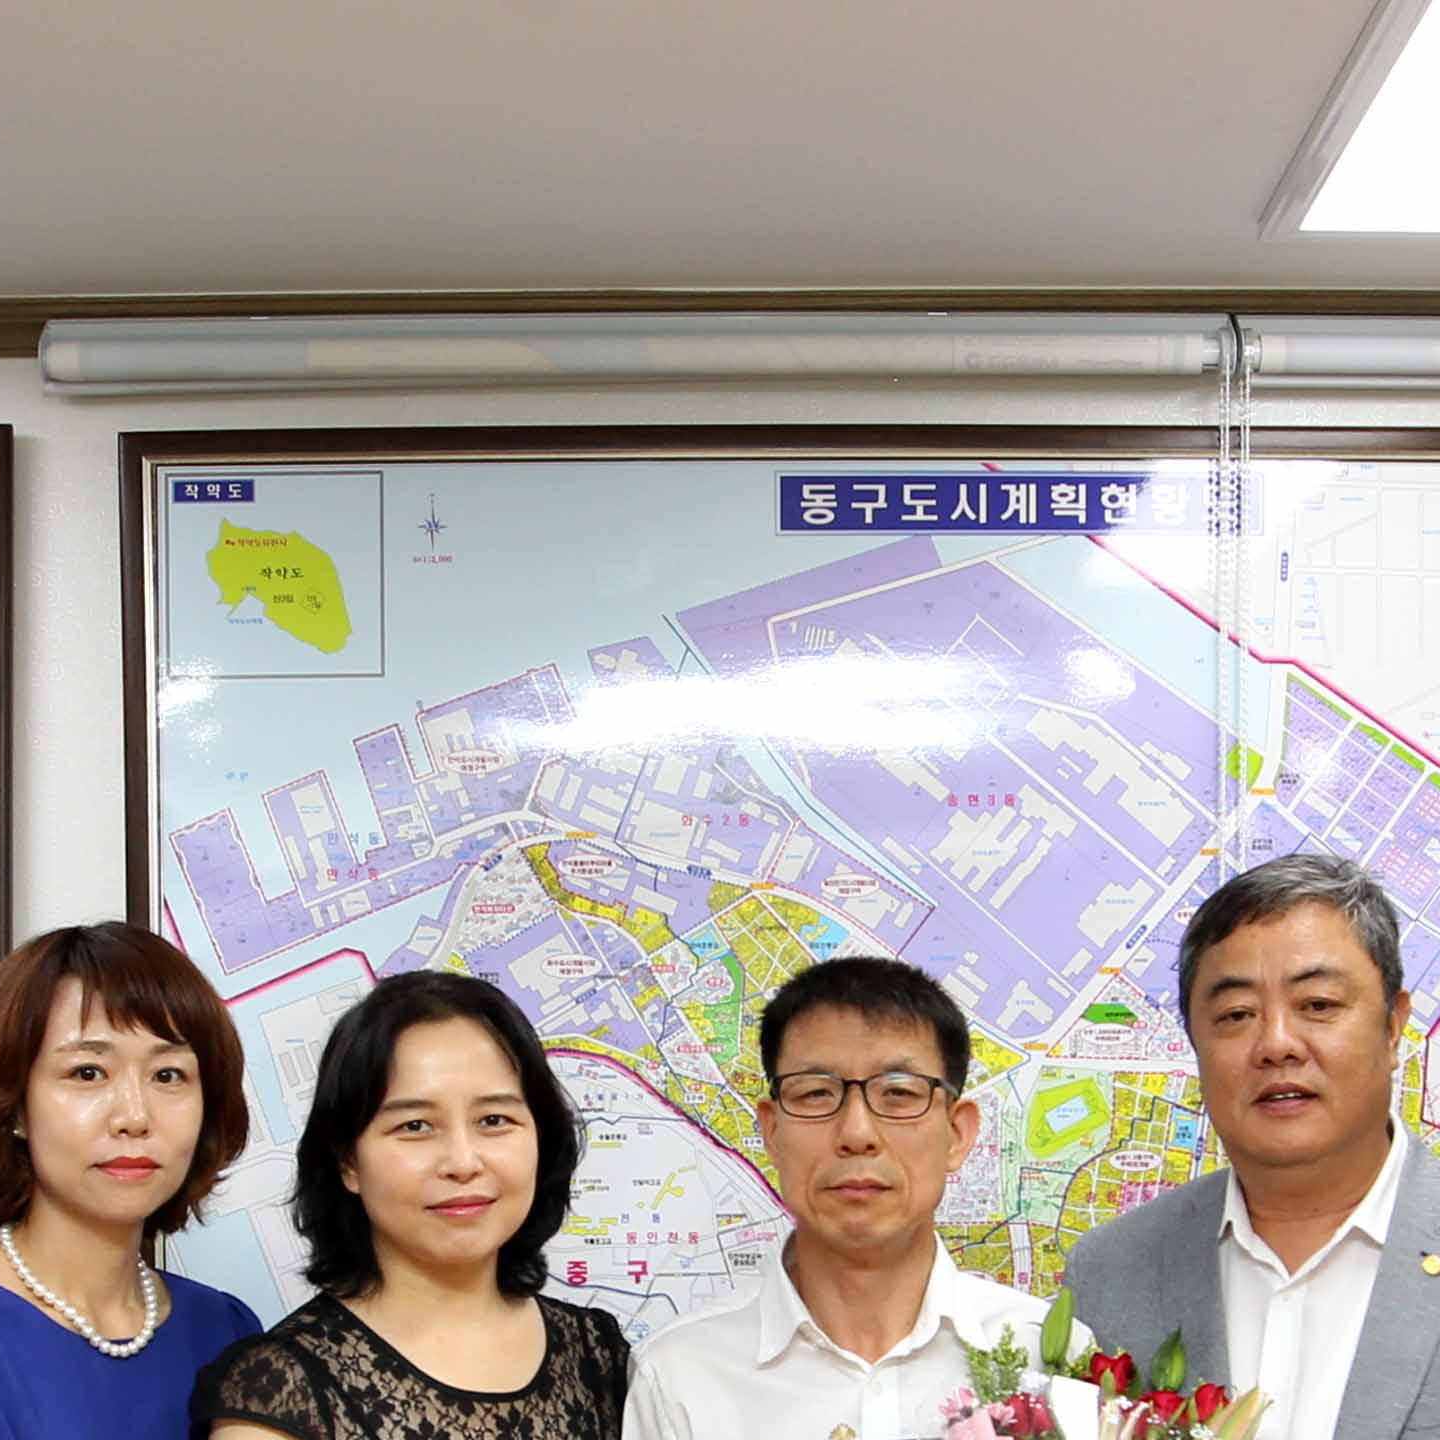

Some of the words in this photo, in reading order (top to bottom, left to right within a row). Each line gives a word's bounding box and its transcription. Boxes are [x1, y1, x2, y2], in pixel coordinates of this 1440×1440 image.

[185, 484, 243, 499] 작약도
[800, 482, 1242, 524] 동구도시계획현황
[260, 567, 304, 580] 작약도
[567, 1260, 648, 1285] 중구
